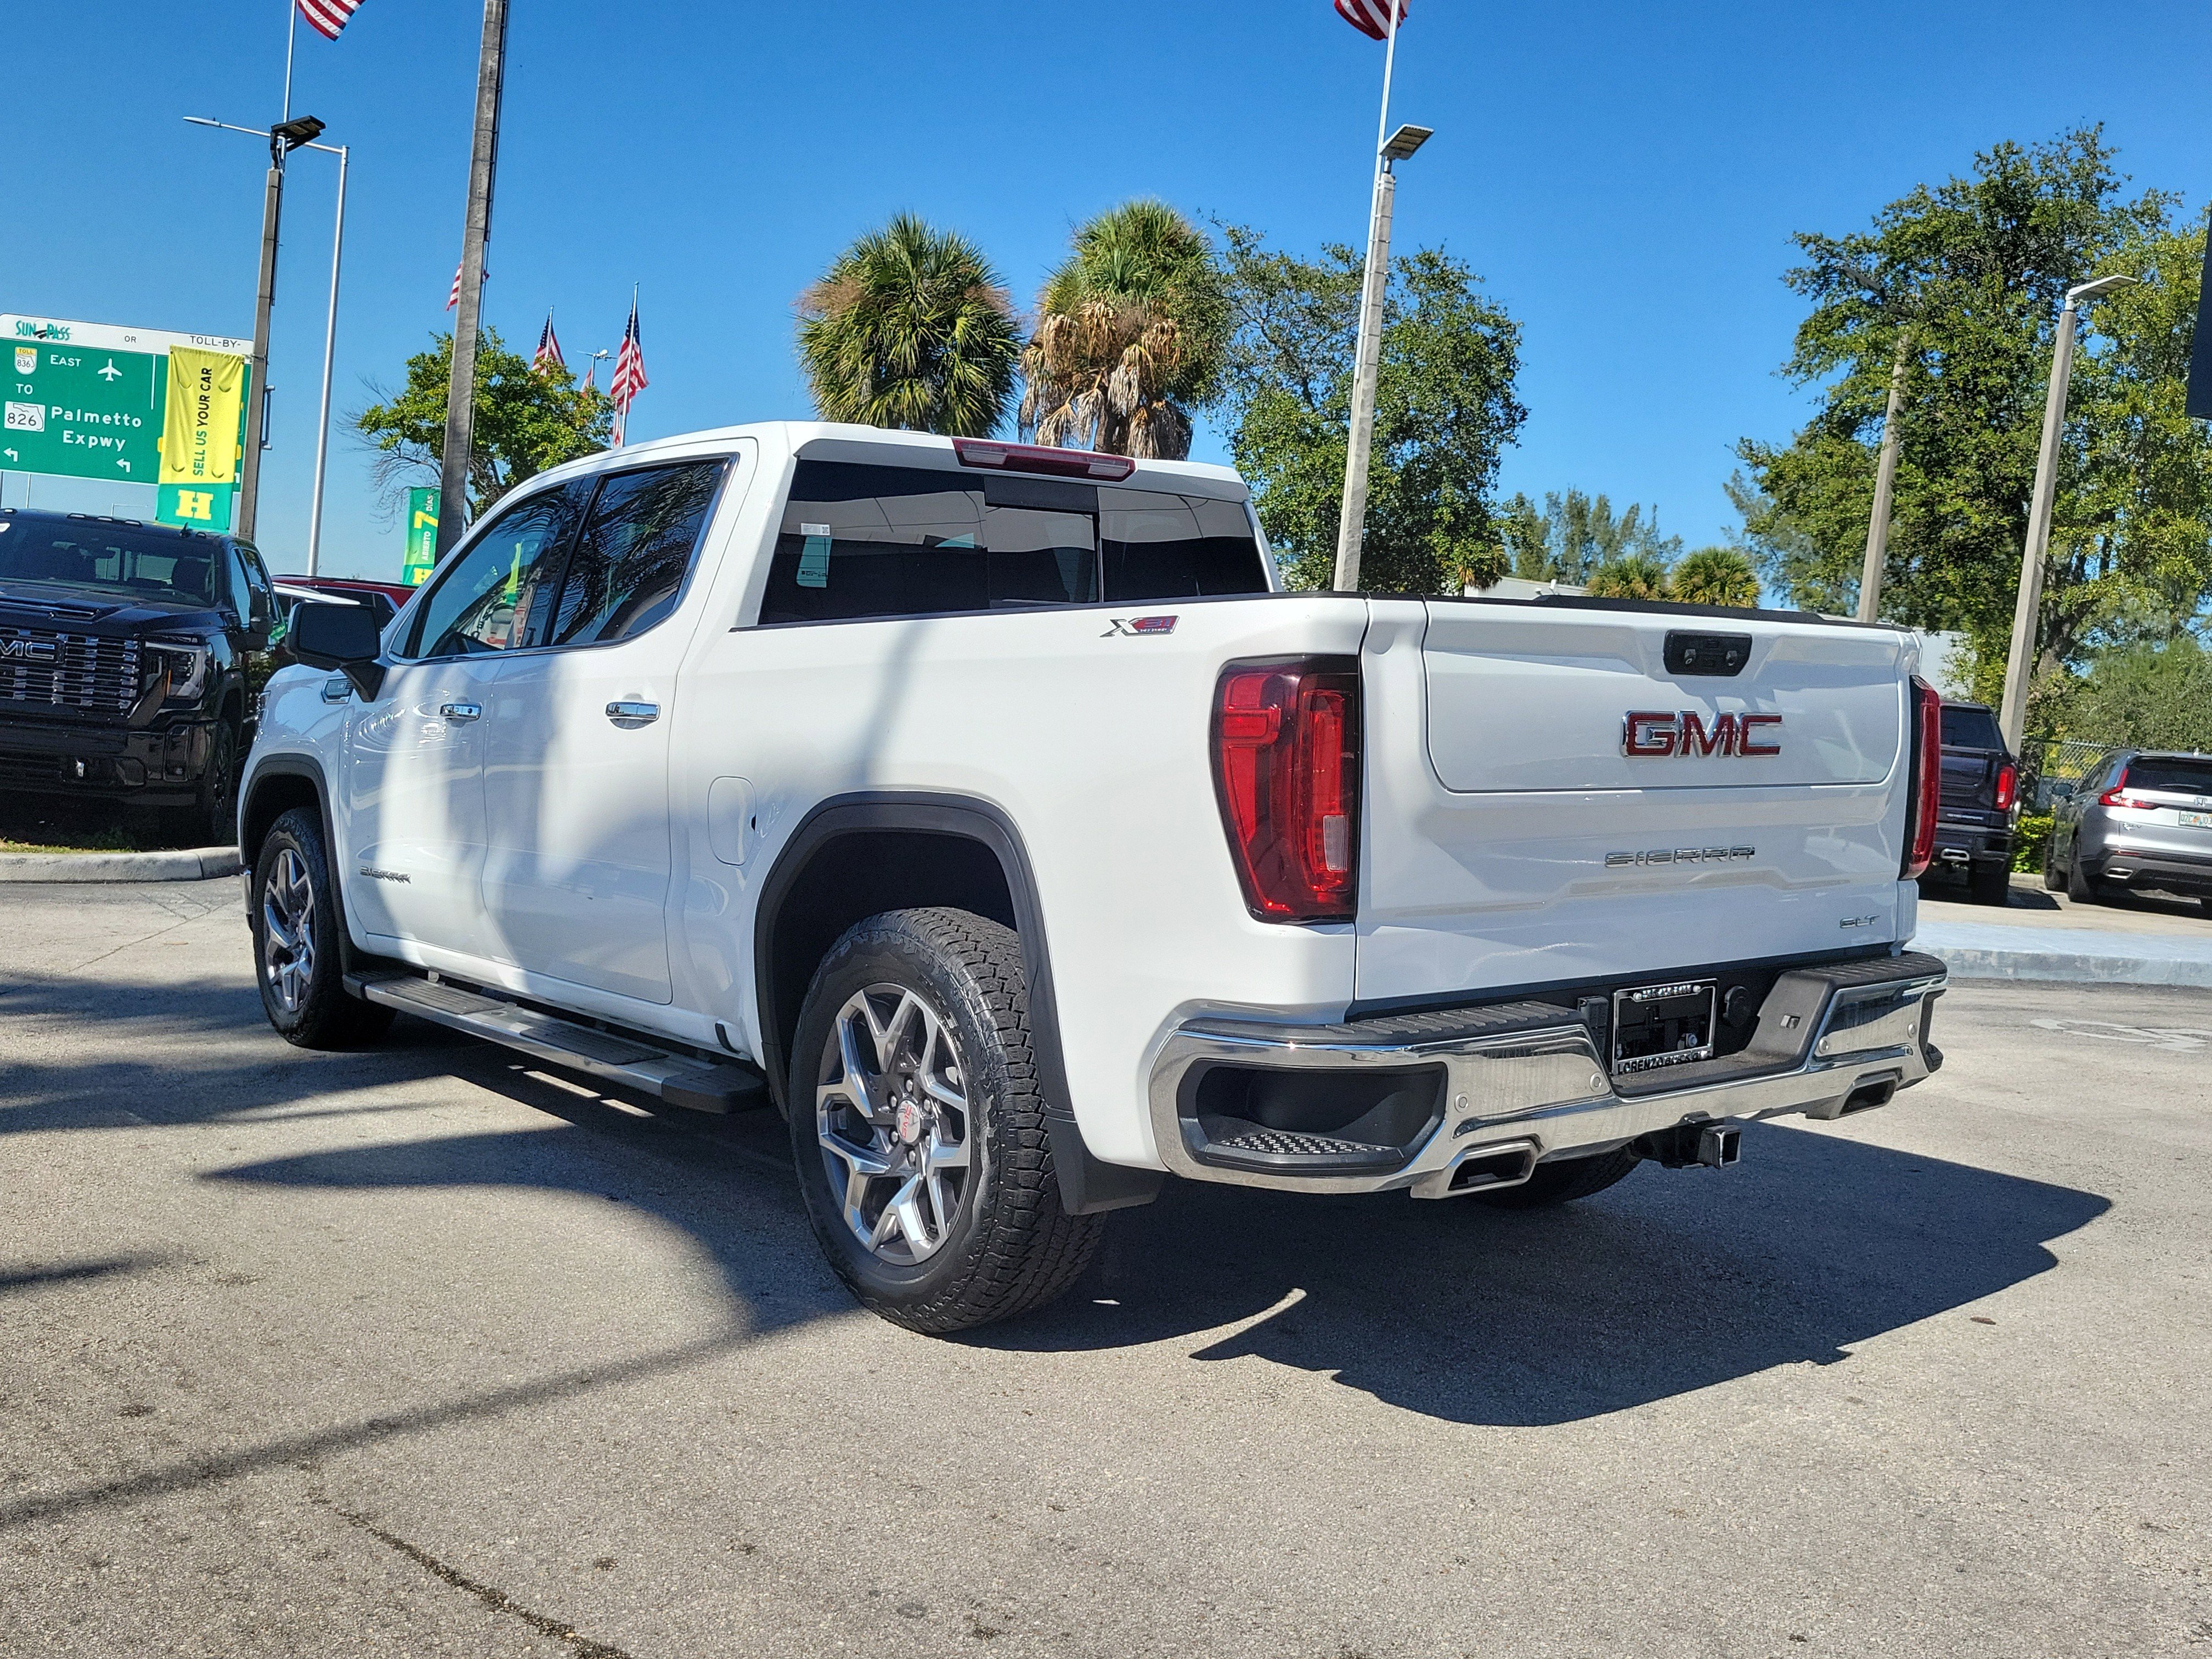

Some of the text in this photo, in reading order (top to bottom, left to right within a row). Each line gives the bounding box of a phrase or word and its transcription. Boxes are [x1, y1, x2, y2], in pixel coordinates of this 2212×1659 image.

[17, 359, 31, 368] 836
[50, 354, 82, 367] EAST
[16, 383, 33, 395] TO
[7, 413, 37, 426] 826
[51, 406, 142, 428] Palmetto
[193, 368, 213, 477] SELL US YOUR CAR
[63, 430, 126, 452] Expwy
[176, 489, 213, 520] H
[414, 510, 438, 529] 7
[0, 639, 55, 659] MC
[1620, 710, 1783, 758] GMC
[1605, 844, 1756, 868] SIERRA
[1839, 914, 1880, 929] SLT
